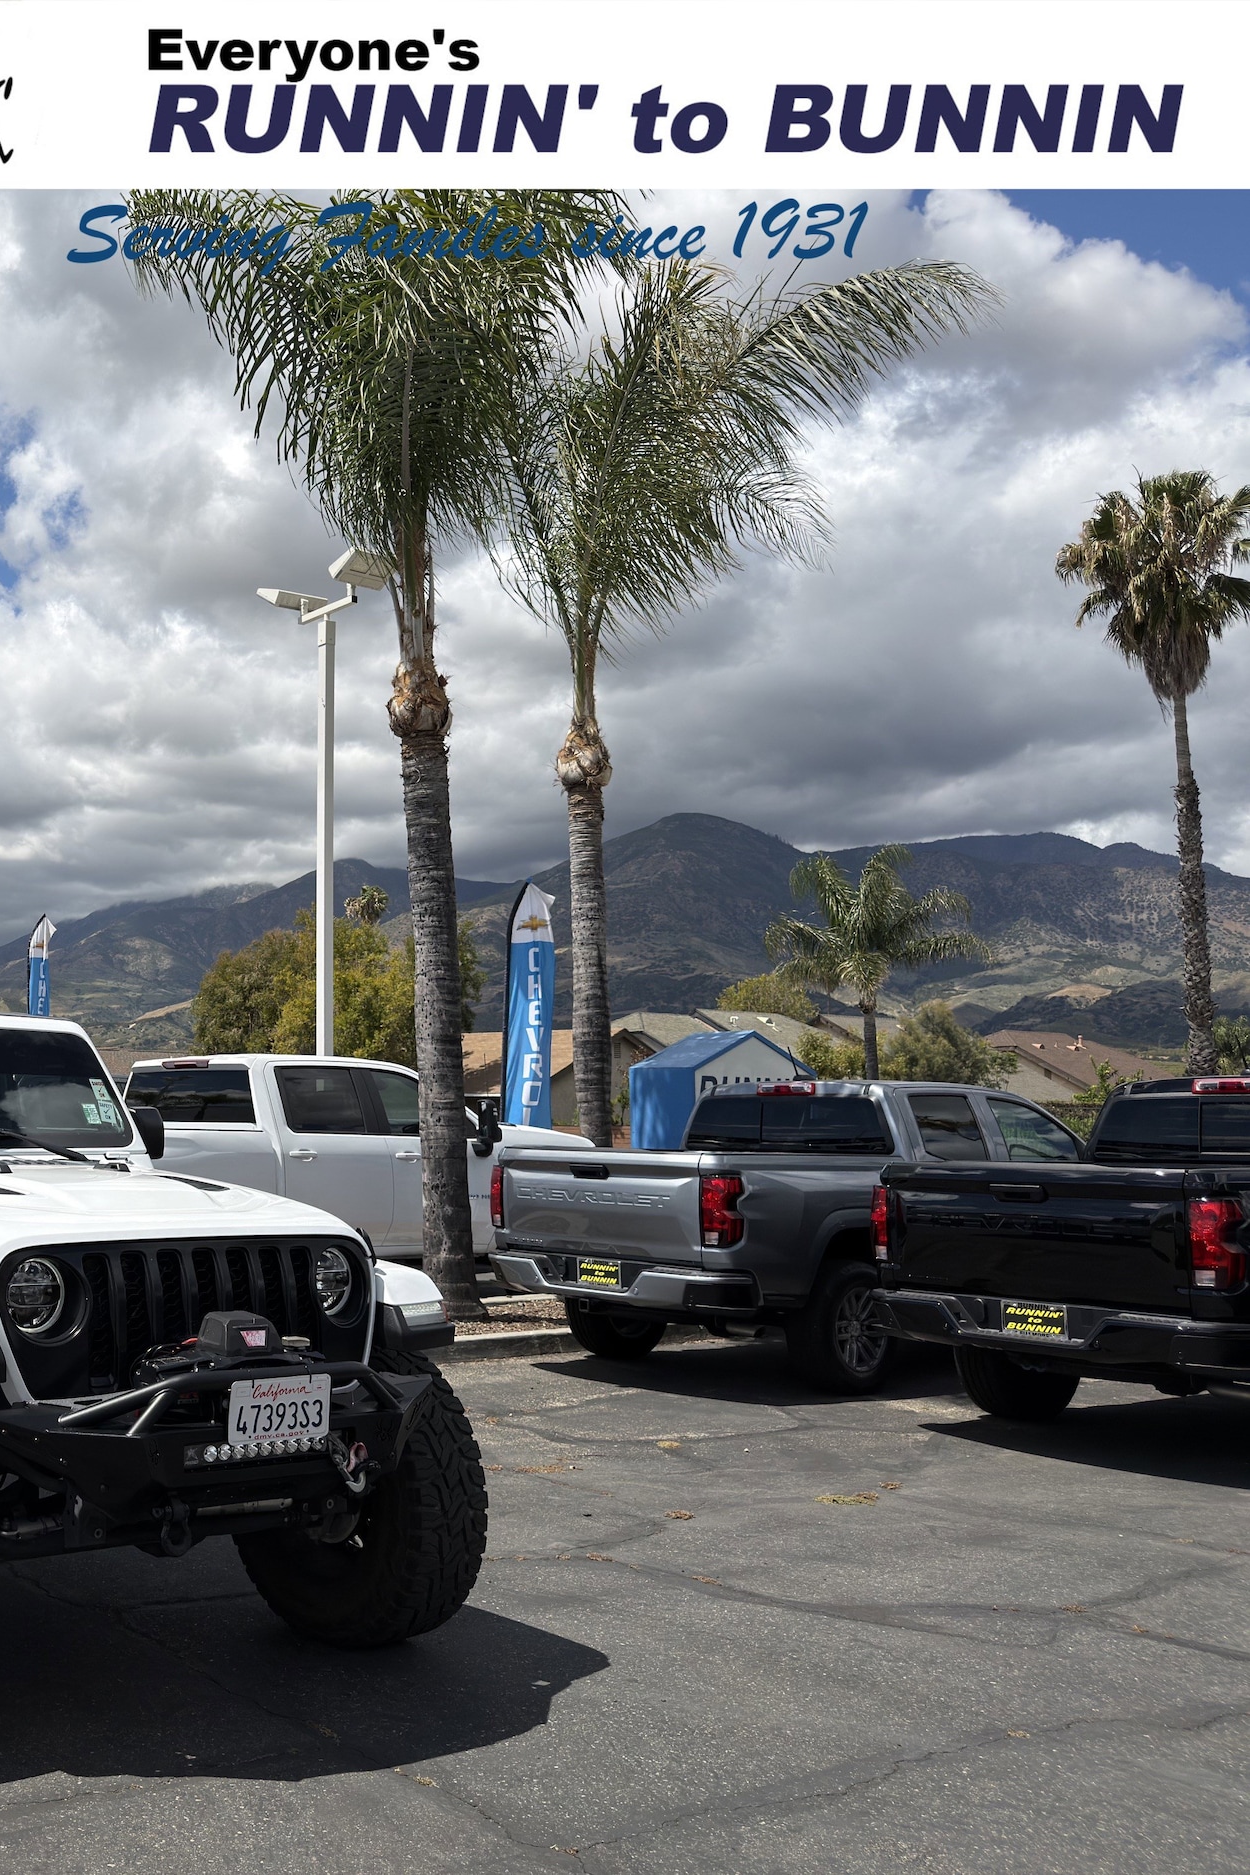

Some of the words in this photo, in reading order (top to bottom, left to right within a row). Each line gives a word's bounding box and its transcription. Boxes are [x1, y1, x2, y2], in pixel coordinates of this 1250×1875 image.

[516, 1186, 671, 1208] CHEVROLET
[580, 1275, 617, 1284] BUNNIN
[1005, 1307, 1064, 1318] RUNNIN'
[1006, 1322, 1062, 1334] BUNNIN
[252, 1382, 312, 1401] California
[236, 1399, 323, 1434] 47393S3
[254, 1430, 304, 1440] dmv.ca.gov
